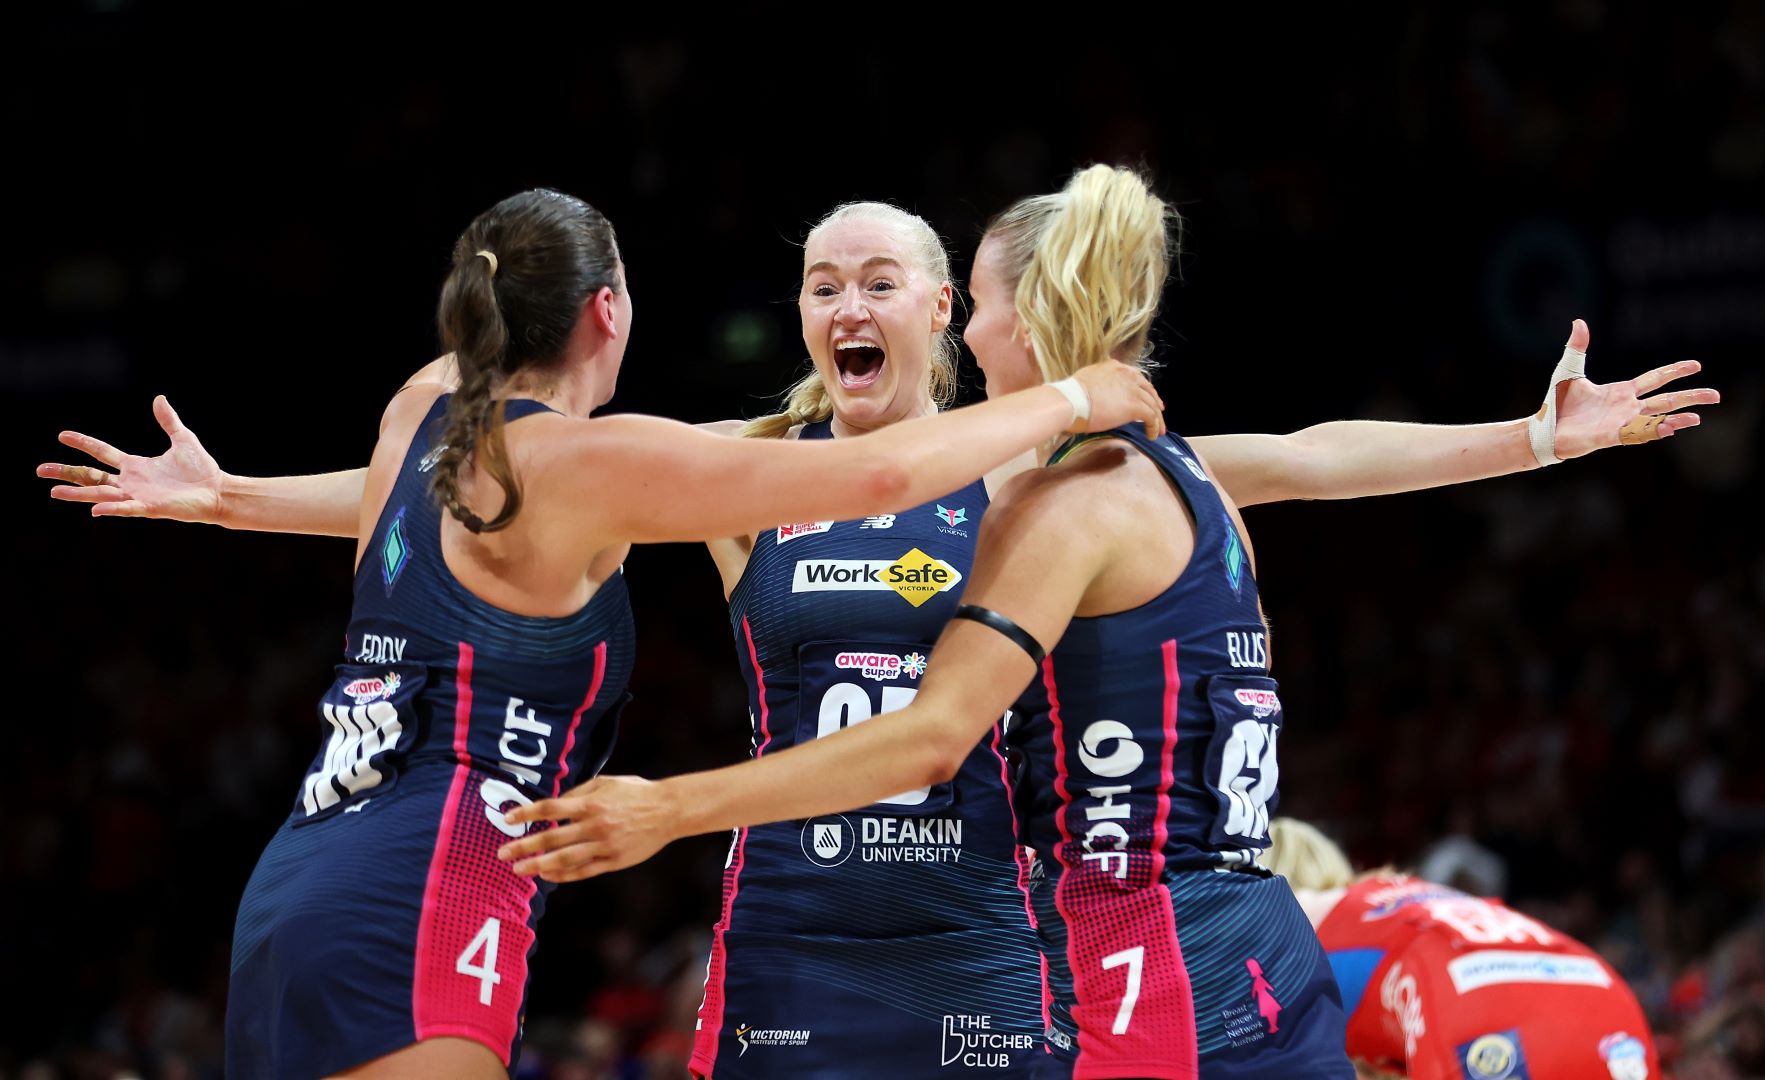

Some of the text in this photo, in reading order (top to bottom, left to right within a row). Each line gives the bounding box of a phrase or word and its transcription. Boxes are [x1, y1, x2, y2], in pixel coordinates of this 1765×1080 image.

[1226, 632, 1266, 668] ELLIS
[838, 655, 899, 668] aware
[865, 668, 897, 678] super
[862, 818, 962, 844] DEAKIN
[862, 847, 962, 862] UNIVERSITY
[457, 918, 500, 1006] 4
[1102, 946, 1144, 1035] 7
[1222, 1004, 1248, 1019] Breast
[957, 1015, 991, 1029] THE
[1224, 1014, 1253, 1029] Cancer
[750, 1030, 811, 1040] VICTORIAN
[1227, 1021, 1263, 1038] Network
[964, 1053, 1010, 1068] CLUB
